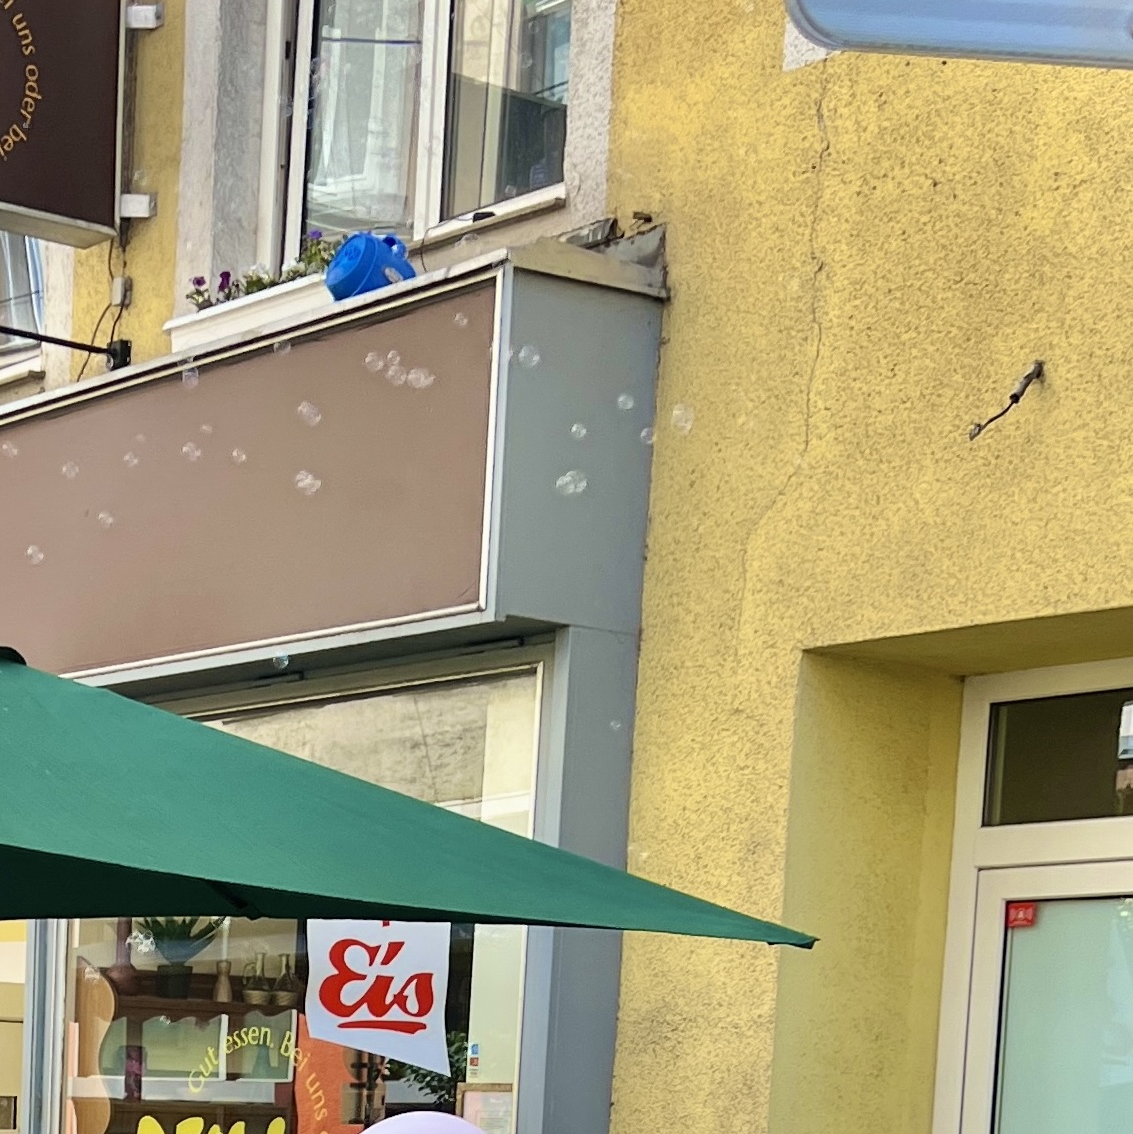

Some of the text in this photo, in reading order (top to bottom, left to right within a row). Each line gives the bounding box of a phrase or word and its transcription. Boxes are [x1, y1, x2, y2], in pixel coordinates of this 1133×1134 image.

[12, 13, 36, 56] uns
[20, 64, 43, 125] oder
[319, 938, 434, 1018] Eis
[188, 1046, 219, 1093] Gut
[225, 1026, 274, 1049] essen.
[281, 1031, 310, 1067] Bei
[305, 1073, 328, 1121] uns
